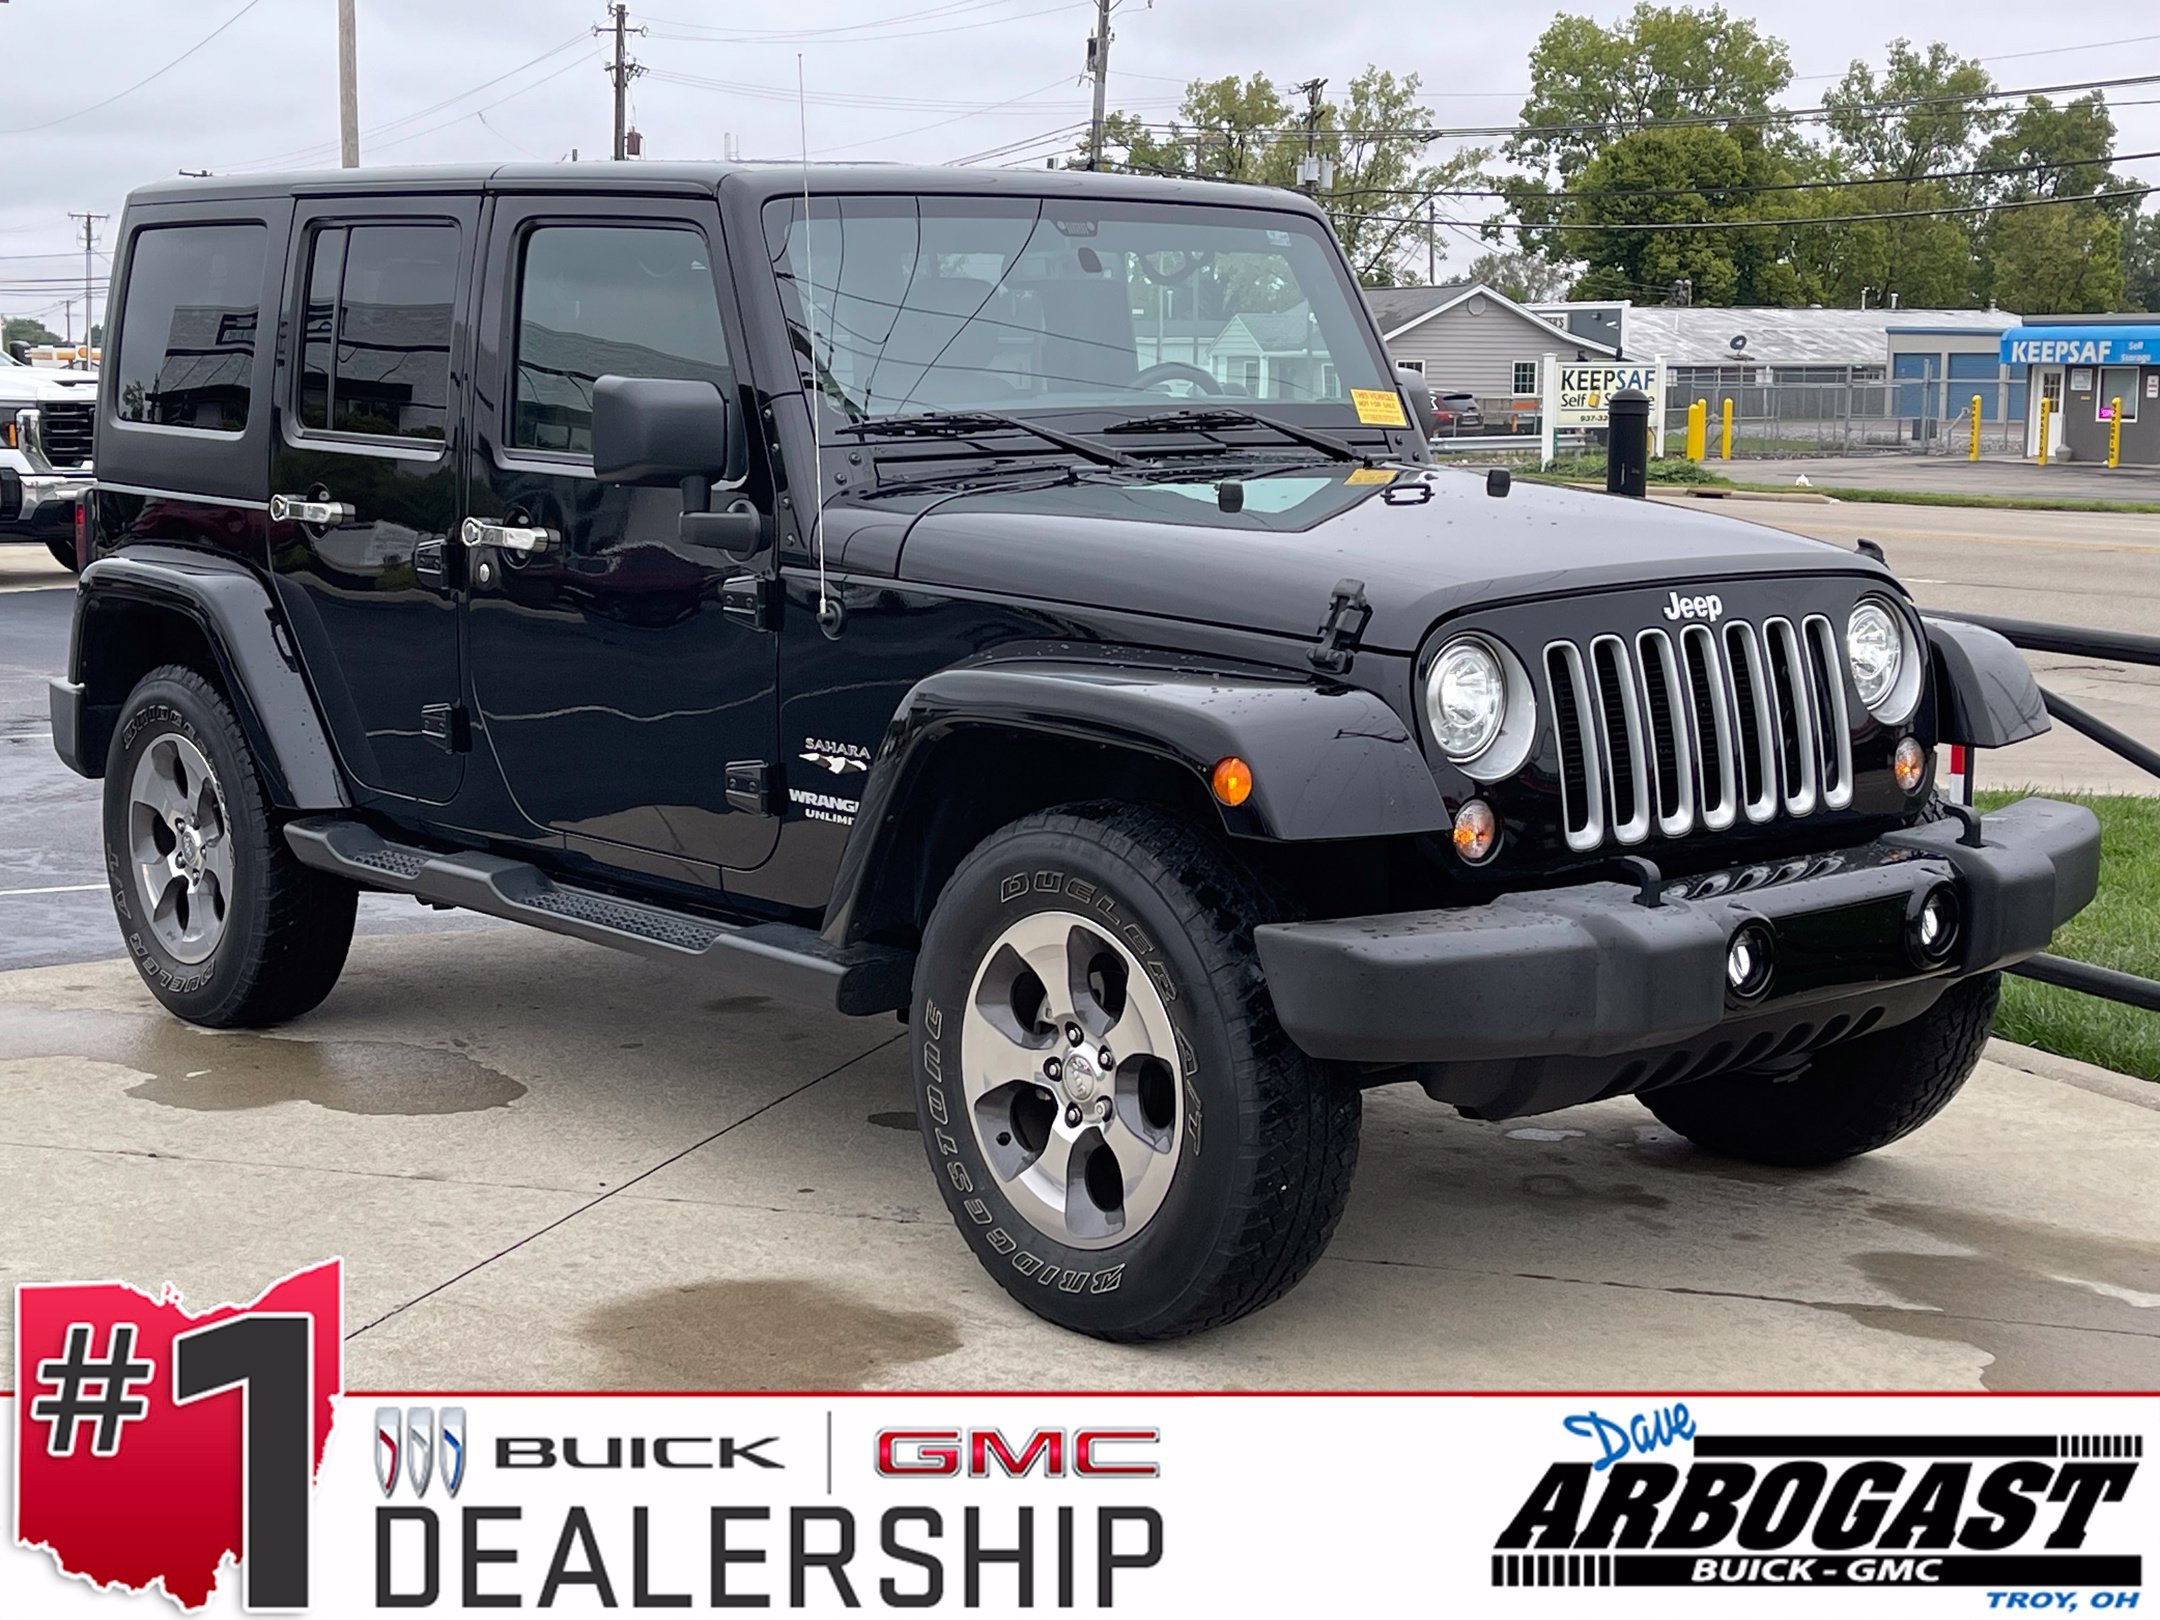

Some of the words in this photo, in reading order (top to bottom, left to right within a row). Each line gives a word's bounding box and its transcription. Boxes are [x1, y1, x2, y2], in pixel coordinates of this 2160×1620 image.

[2011, 341, 2112, 363] KEEPSAF
[1561, 369, 1656, 391] KEEPSAF
[1561, 393, 1587, 408] Self
[1663, 591, 1723, 622] Jeep
[804, 737, 872, 760] SAHARA
[1000, 869, 1178, 1003] DUELER
[1176, 1024, 1206, 1156] A/T
[922, 998, 1124, 1295] BRIDGESTONE
